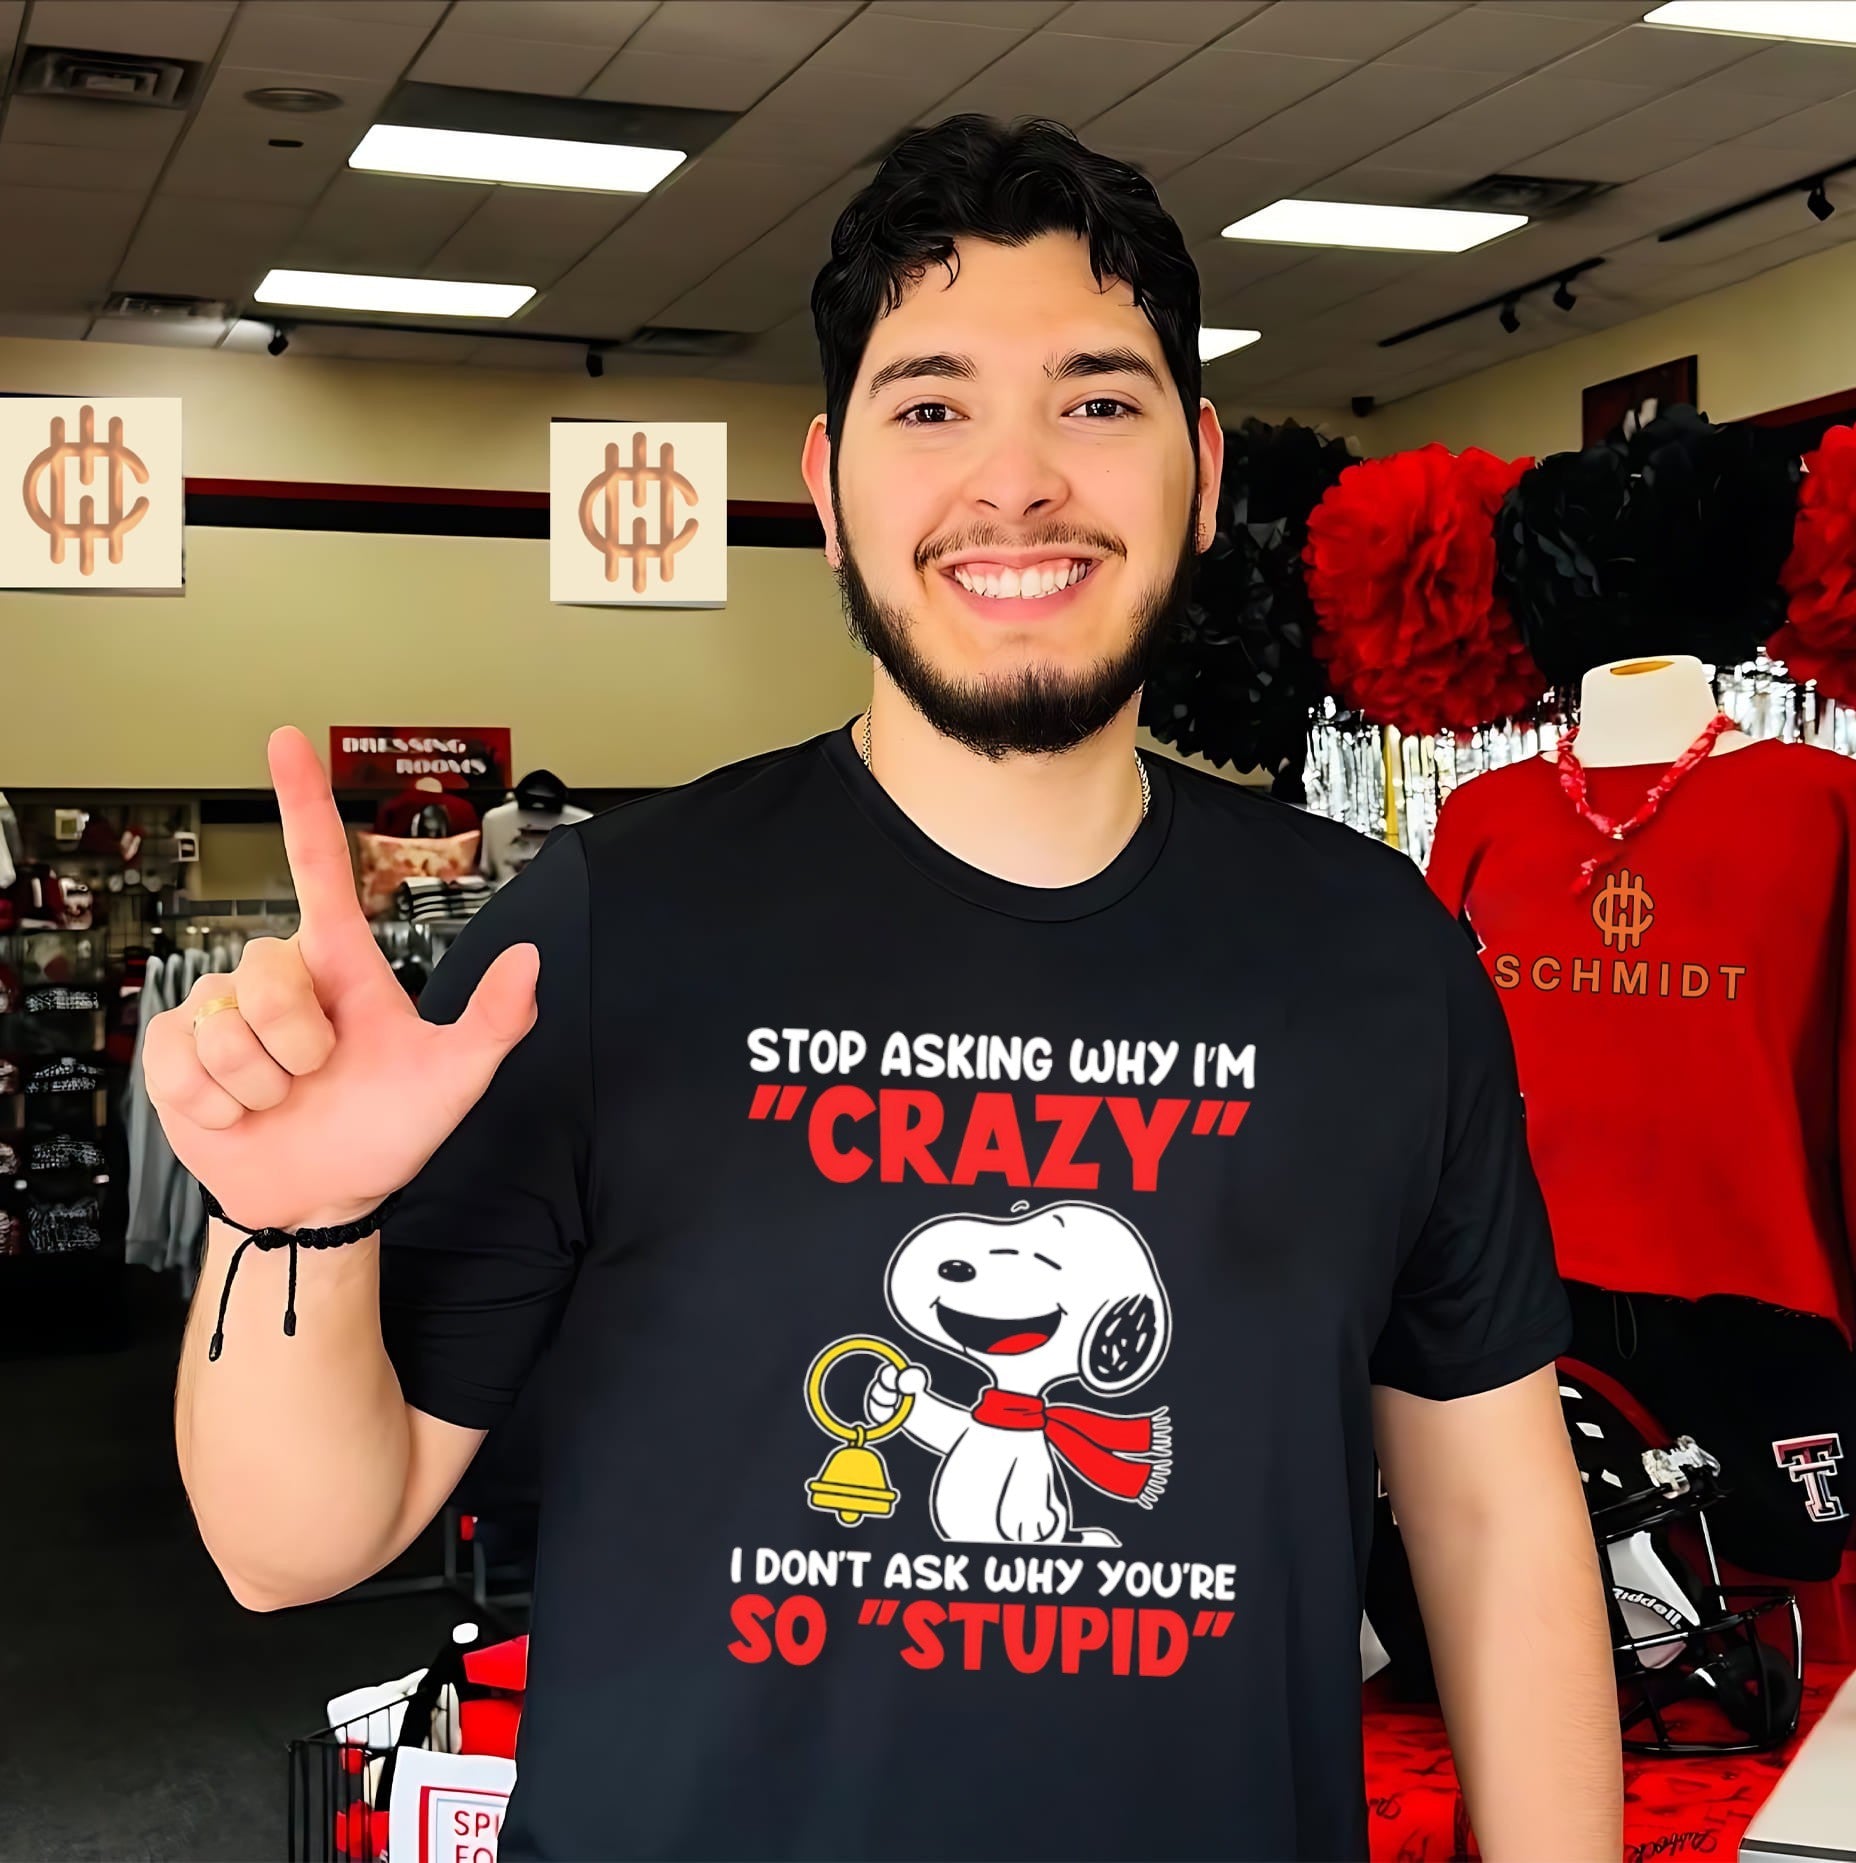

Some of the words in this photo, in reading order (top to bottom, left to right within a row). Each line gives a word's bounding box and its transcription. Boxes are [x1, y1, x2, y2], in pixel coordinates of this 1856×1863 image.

[342, 737, 467, 754] DRESSING
[396, 758, 487, 775] ROOMS
[1494, 954, 1747, 1000] SCHMIDT
[746, 1027, 867, 1075] STOP
[880, 1030, 1053, 1082] ASKING
[1069, 1038, 1180, 1087] WHY
[1193, 1042, 1257, 1090] I'M
[748, 1084, 1251, 1192] "CRAZY"
[730, 1546, 743, 1584] I
[755, 1547, 872, 1588] DON'T
[883, 1552, 970, 1592] ASK
[984, 1555, 1084, 1596] WHY
[1096, 1559, 1237, 1601] YOU'RE
[1611, 1587, 1682, 1626] Riddell
[727, 1593, 828, 1666] SO
[857, 1598, 1235, 1678] "STUPID"
